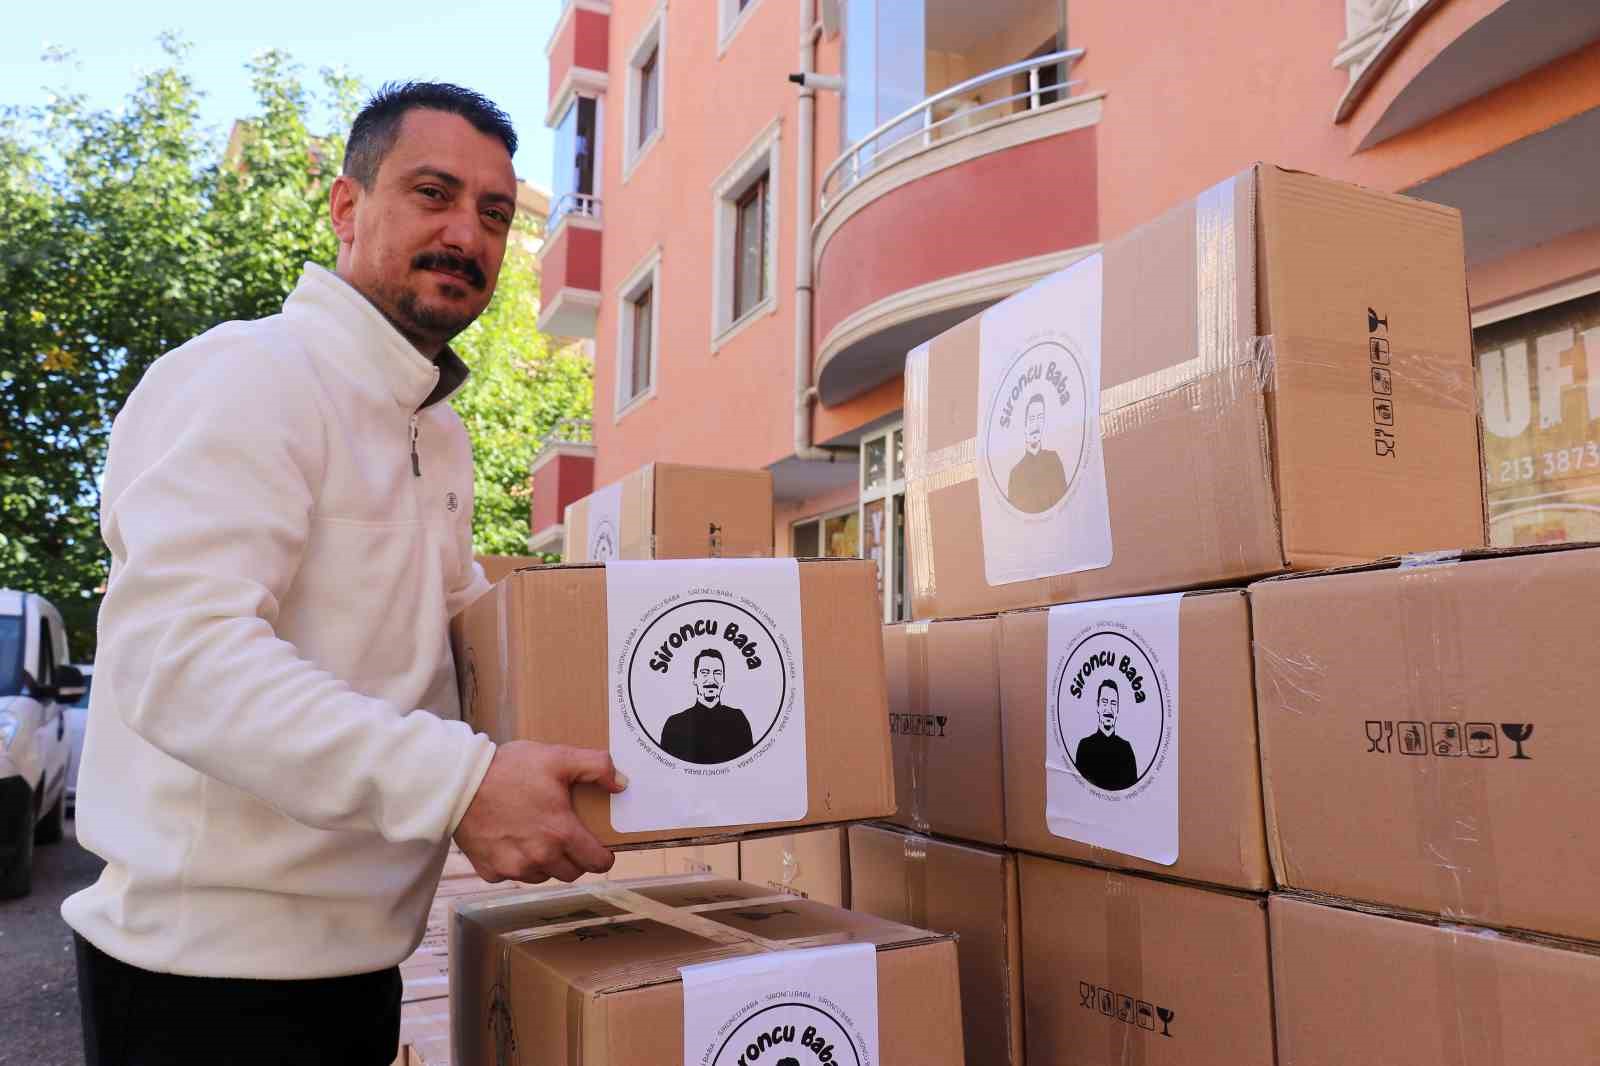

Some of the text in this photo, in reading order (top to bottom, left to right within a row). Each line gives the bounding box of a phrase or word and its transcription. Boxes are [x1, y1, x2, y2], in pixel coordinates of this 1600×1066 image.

[1000, 361, 1070, 429] Sironcu Baba
[1502, 456, 1534, 481] 213
[649, 619, 718, 674] Sironcu
[723, 622, 762, 670] Baba
[1070, 651, 1115, 699] Sironcu
[1119, 655, 1146, 703] Baba
[738, 1025, 796, 1066] roncu
